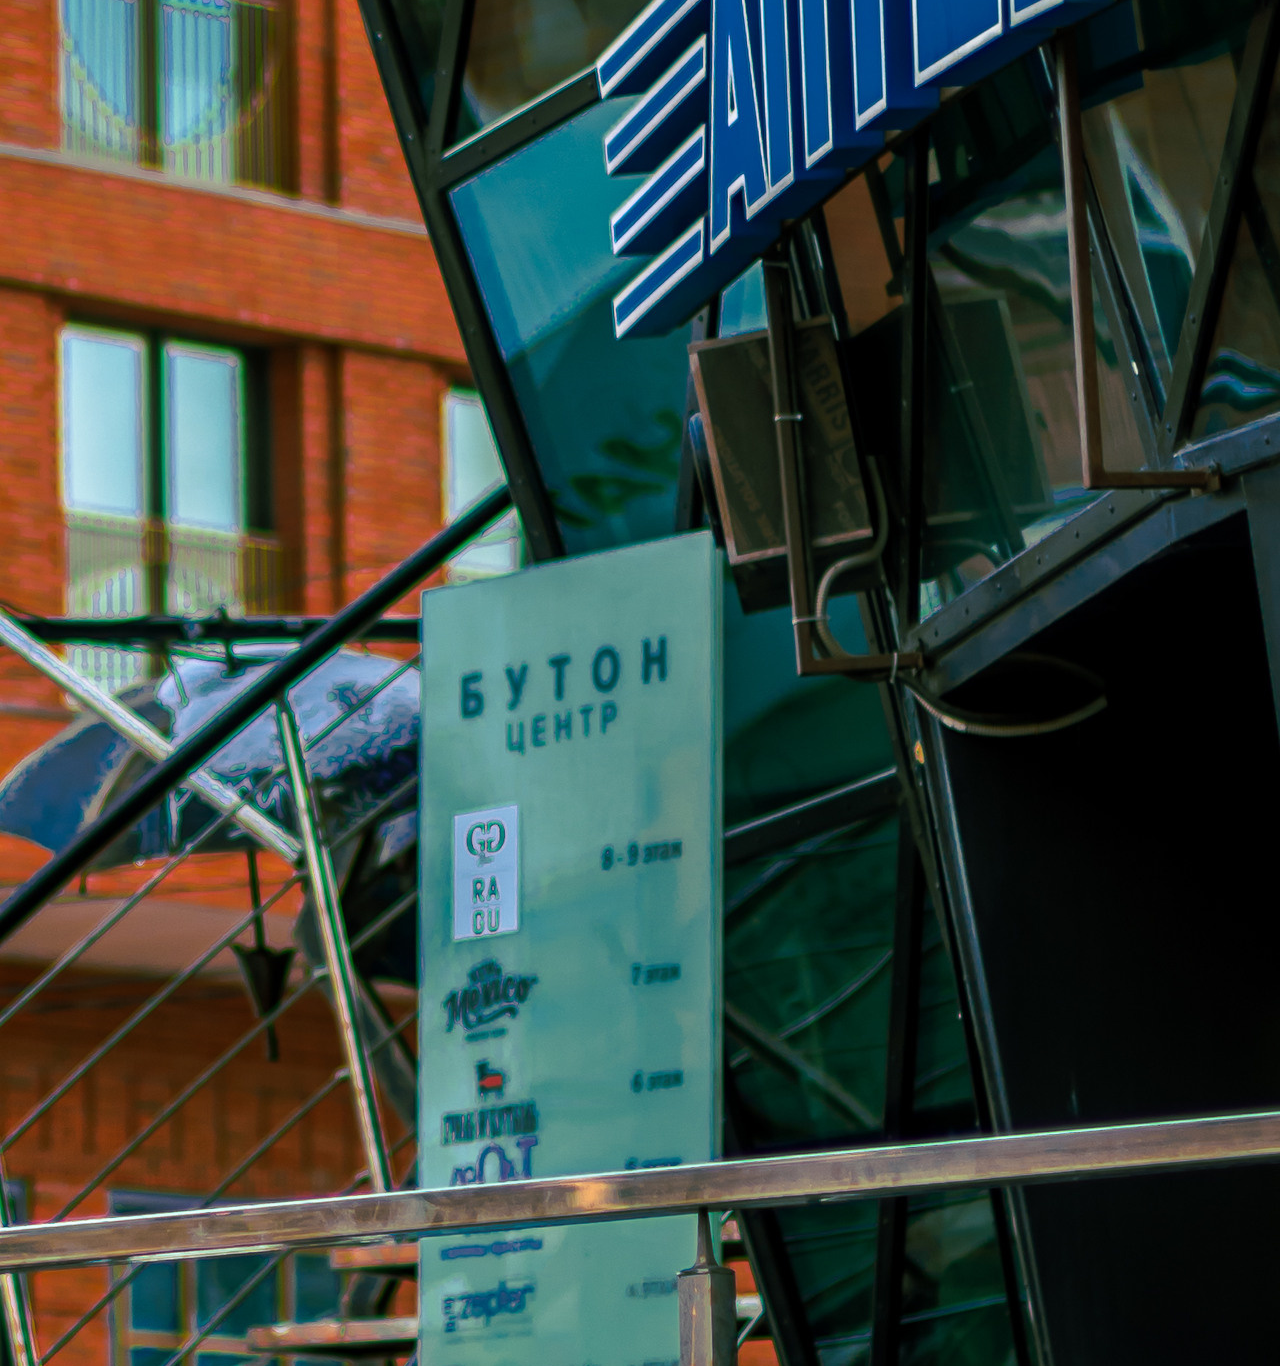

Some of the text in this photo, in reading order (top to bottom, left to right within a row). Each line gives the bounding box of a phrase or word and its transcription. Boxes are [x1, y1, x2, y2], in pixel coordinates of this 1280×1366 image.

[460, 636, 668, 719] БУТОН
[505, 700, 618, 756] ЦЕНТР
[471, 874, 500, 905] RA
